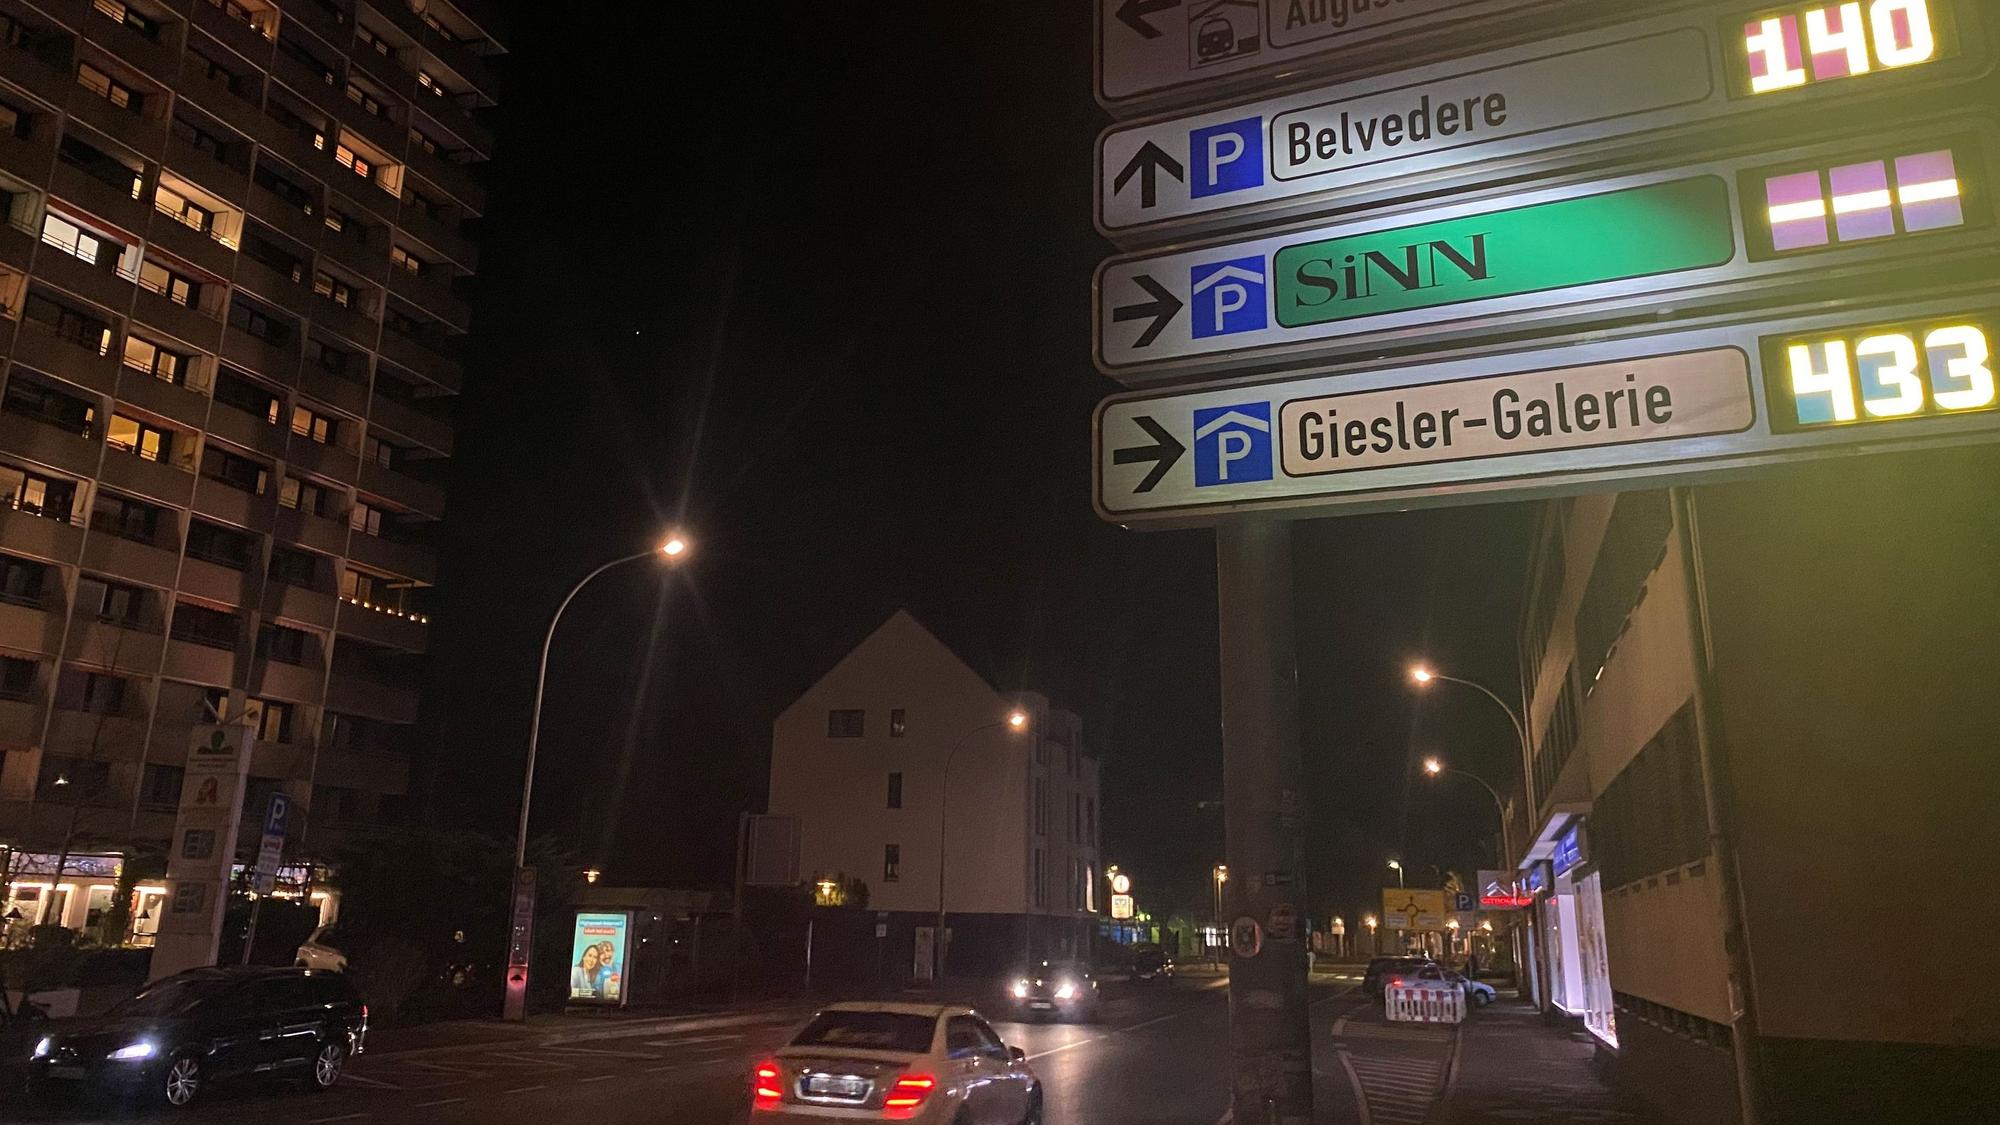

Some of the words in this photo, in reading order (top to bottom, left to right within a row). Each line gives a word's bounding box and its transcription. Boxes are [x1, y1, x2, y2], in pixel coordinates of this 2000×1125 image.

[1284, 0, 1404, 30] Aug
[1745, 0, 1934, 93] 140
[1207, 132, 1245, 186] P
[1288, 92, 1507, 167] Belvedere
[1214, 282, 1248, 332] P
[1788, 325, 1995, 421] 433
[1298, 373, 1674, 462] Giesler-Galerie
[1216, 430, 1252, 480] P
